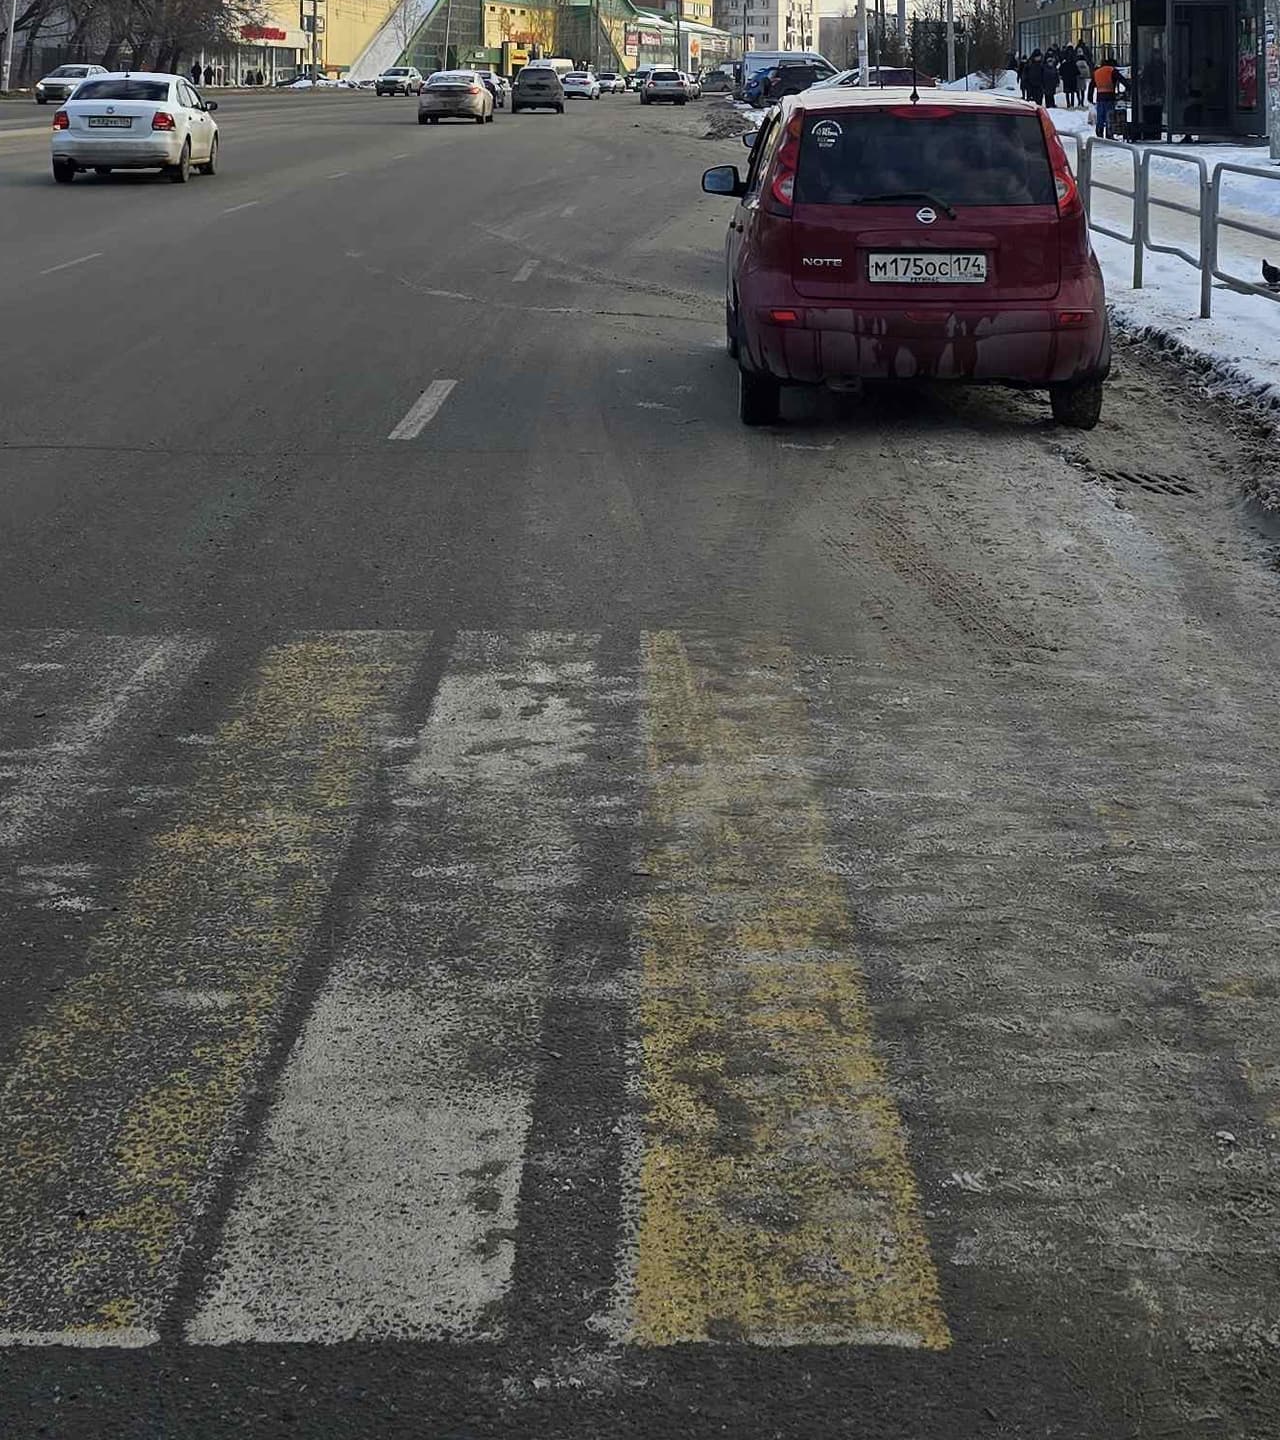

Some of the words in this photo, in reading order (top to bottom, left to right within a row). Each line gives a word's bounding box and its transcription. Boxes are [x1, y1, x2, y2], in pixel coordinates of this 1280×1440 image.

[802, 257, 843, 267] NOTE
[874, 257, 949, 276] М175ОС
[953, 256, 981, 271] 174
